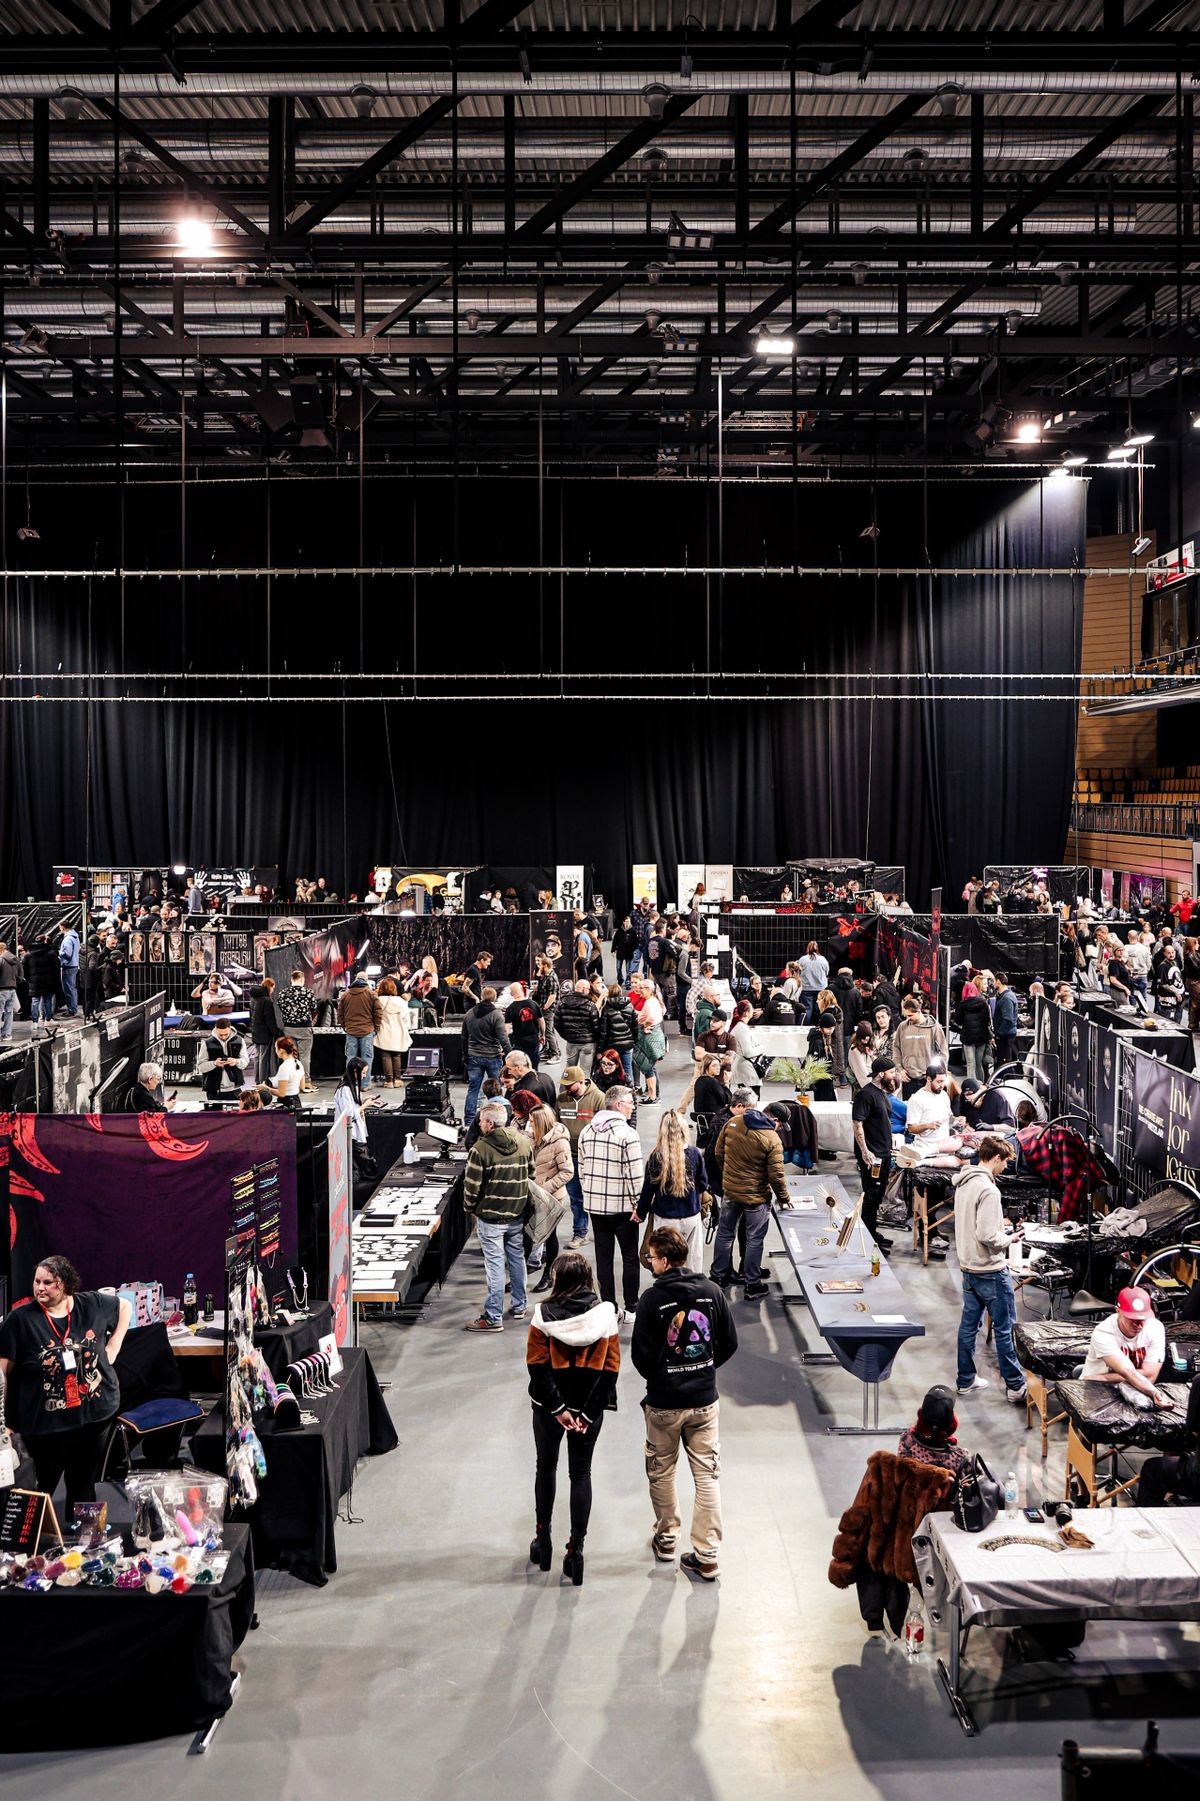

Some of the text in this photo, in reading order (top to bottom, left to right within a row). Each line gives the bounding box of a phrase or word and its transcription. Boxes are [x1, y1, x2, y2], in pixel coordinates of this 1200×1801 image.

[164, 1055, 186, 1065] BRUSH
[164, 1071, 180, 1080] SIGN
[1169, 1076, 1192, 1121] Ink
